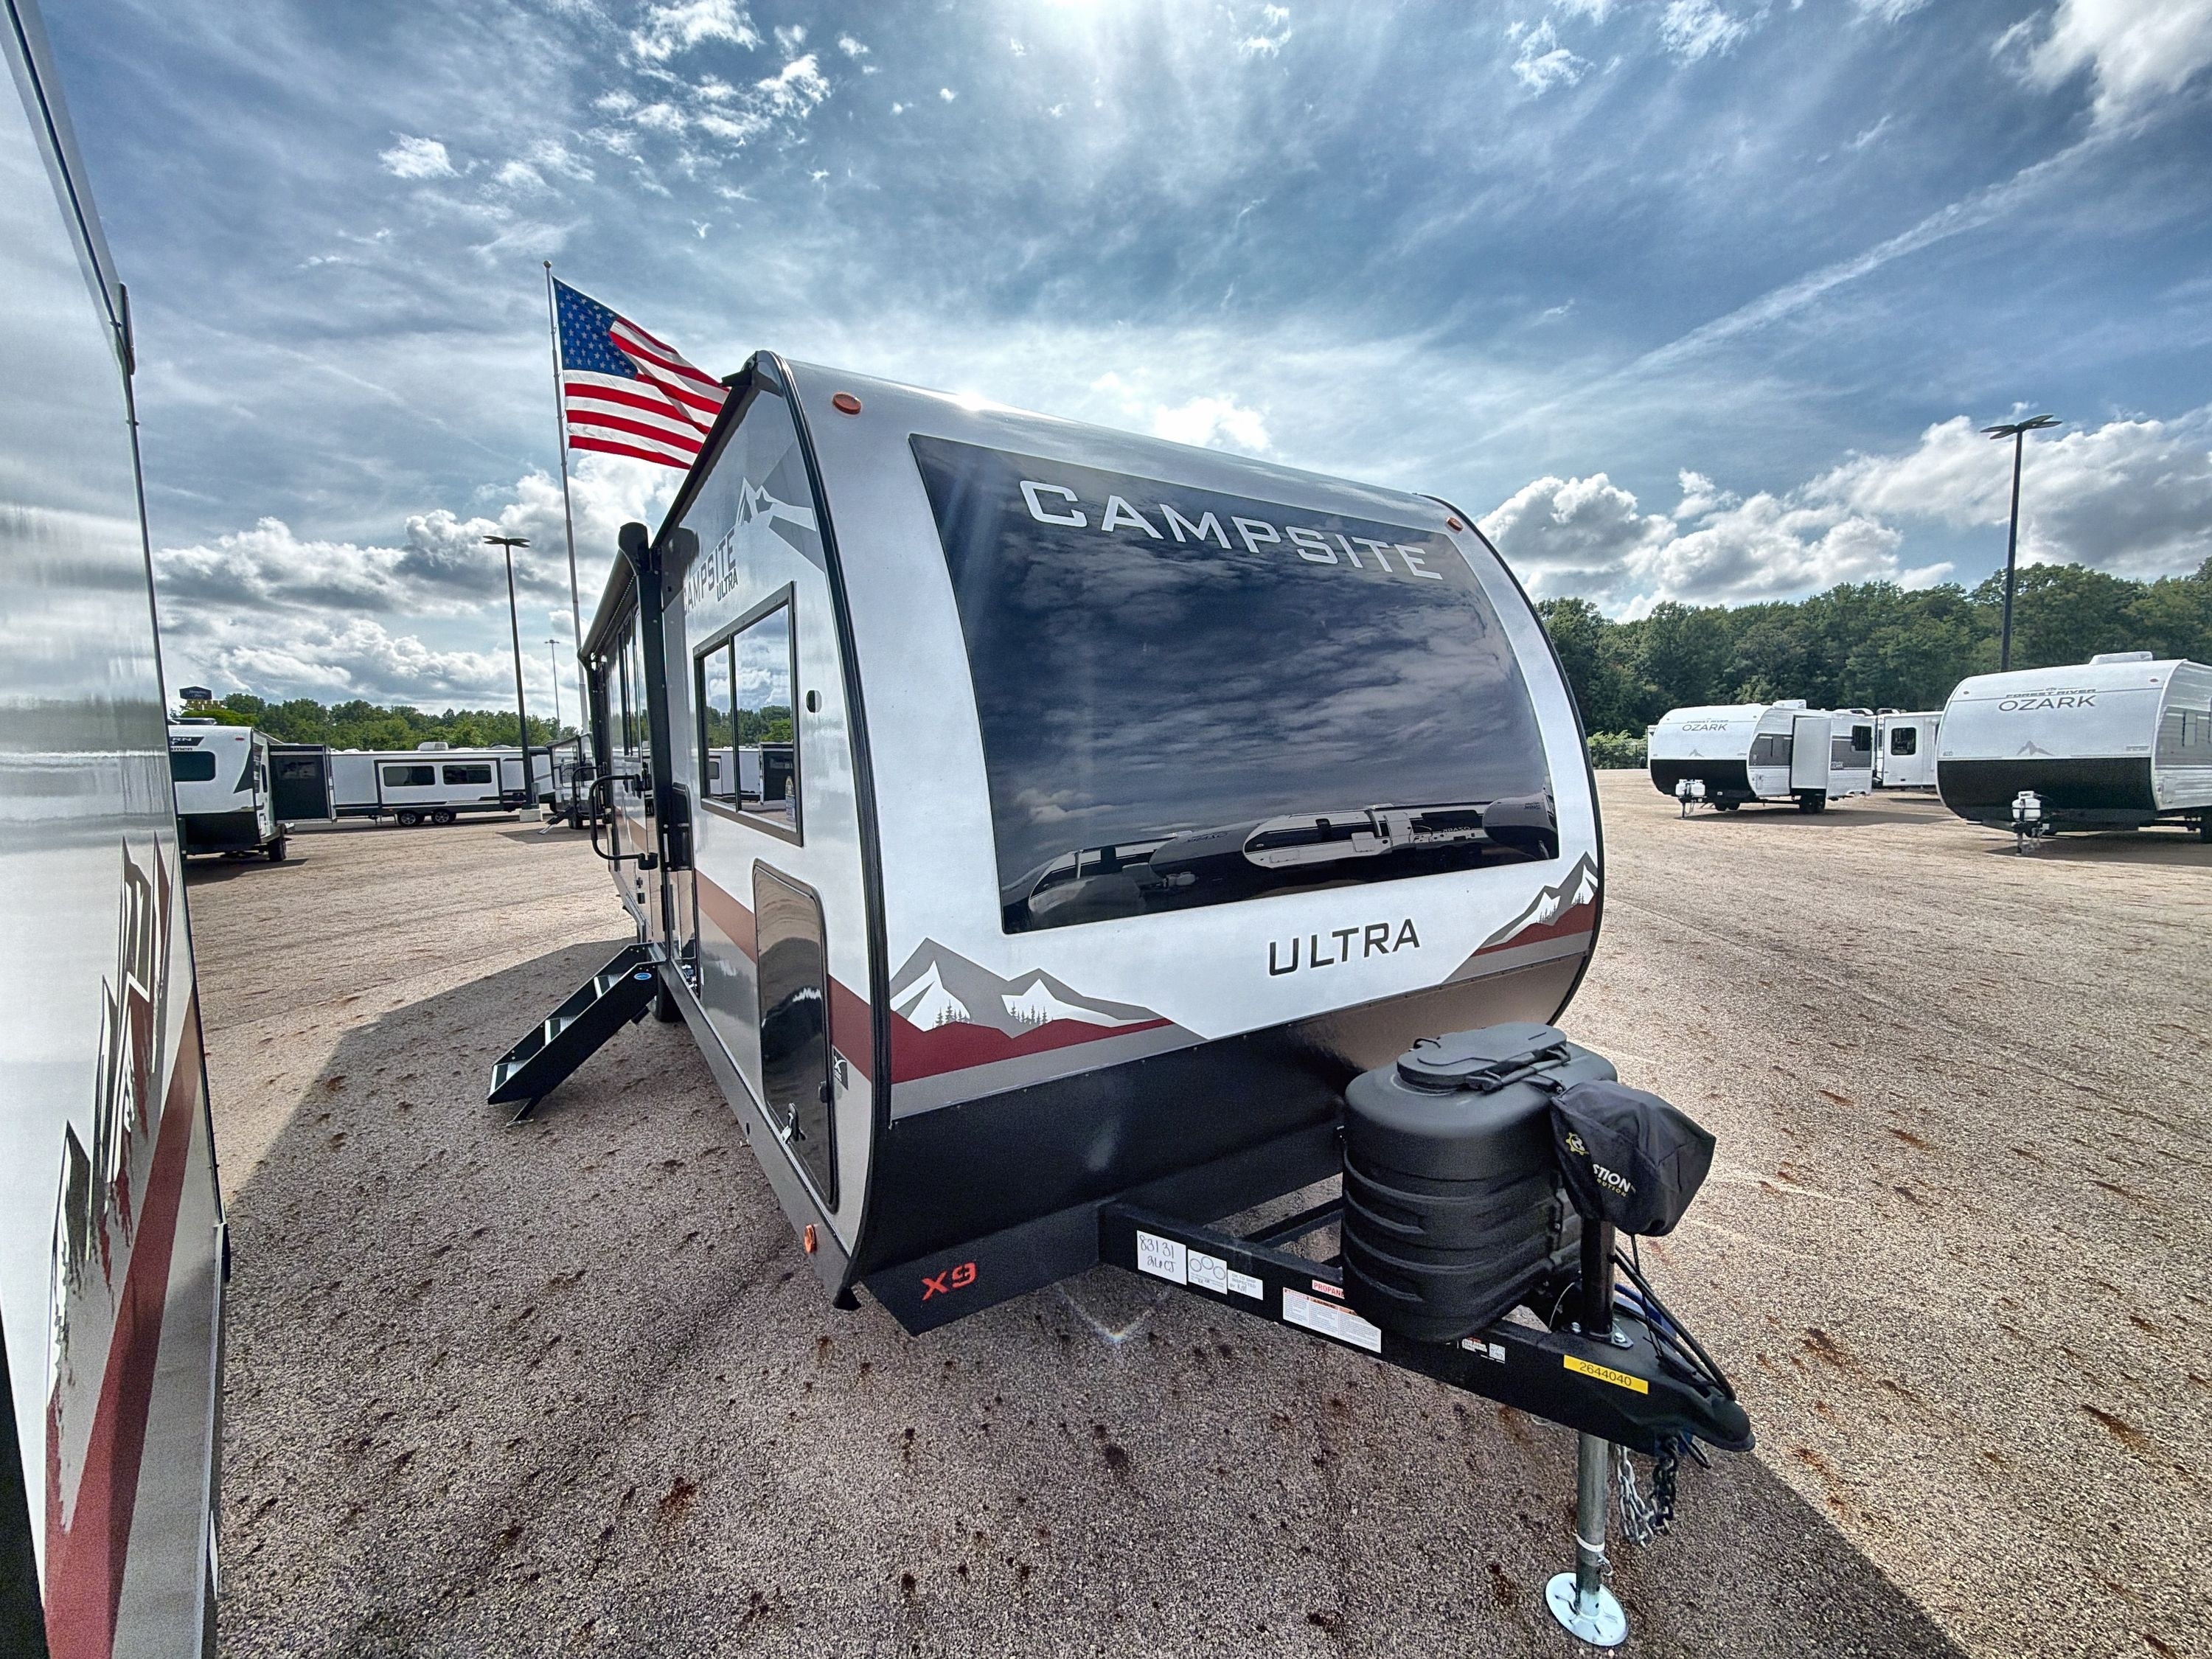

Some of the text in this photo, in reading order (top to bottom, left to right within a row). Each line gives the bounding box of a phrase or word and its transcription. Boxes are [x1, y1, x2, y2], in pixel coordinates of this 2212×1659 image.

[1020, 480, 1443, 580] CAMPSITE
[717, 568, 738, 602] ULTRA
[1998, 695, 2096, 712] OZARK
[1682, 723, 1728, 731] OZARK
[1269, 918, 1421, 975] ULTRA
[1593, 1164, 1632, 1192] STION
[921, 1262, 977, 1301] X9
[1579, 1362, 1632, 1386] 2644040
